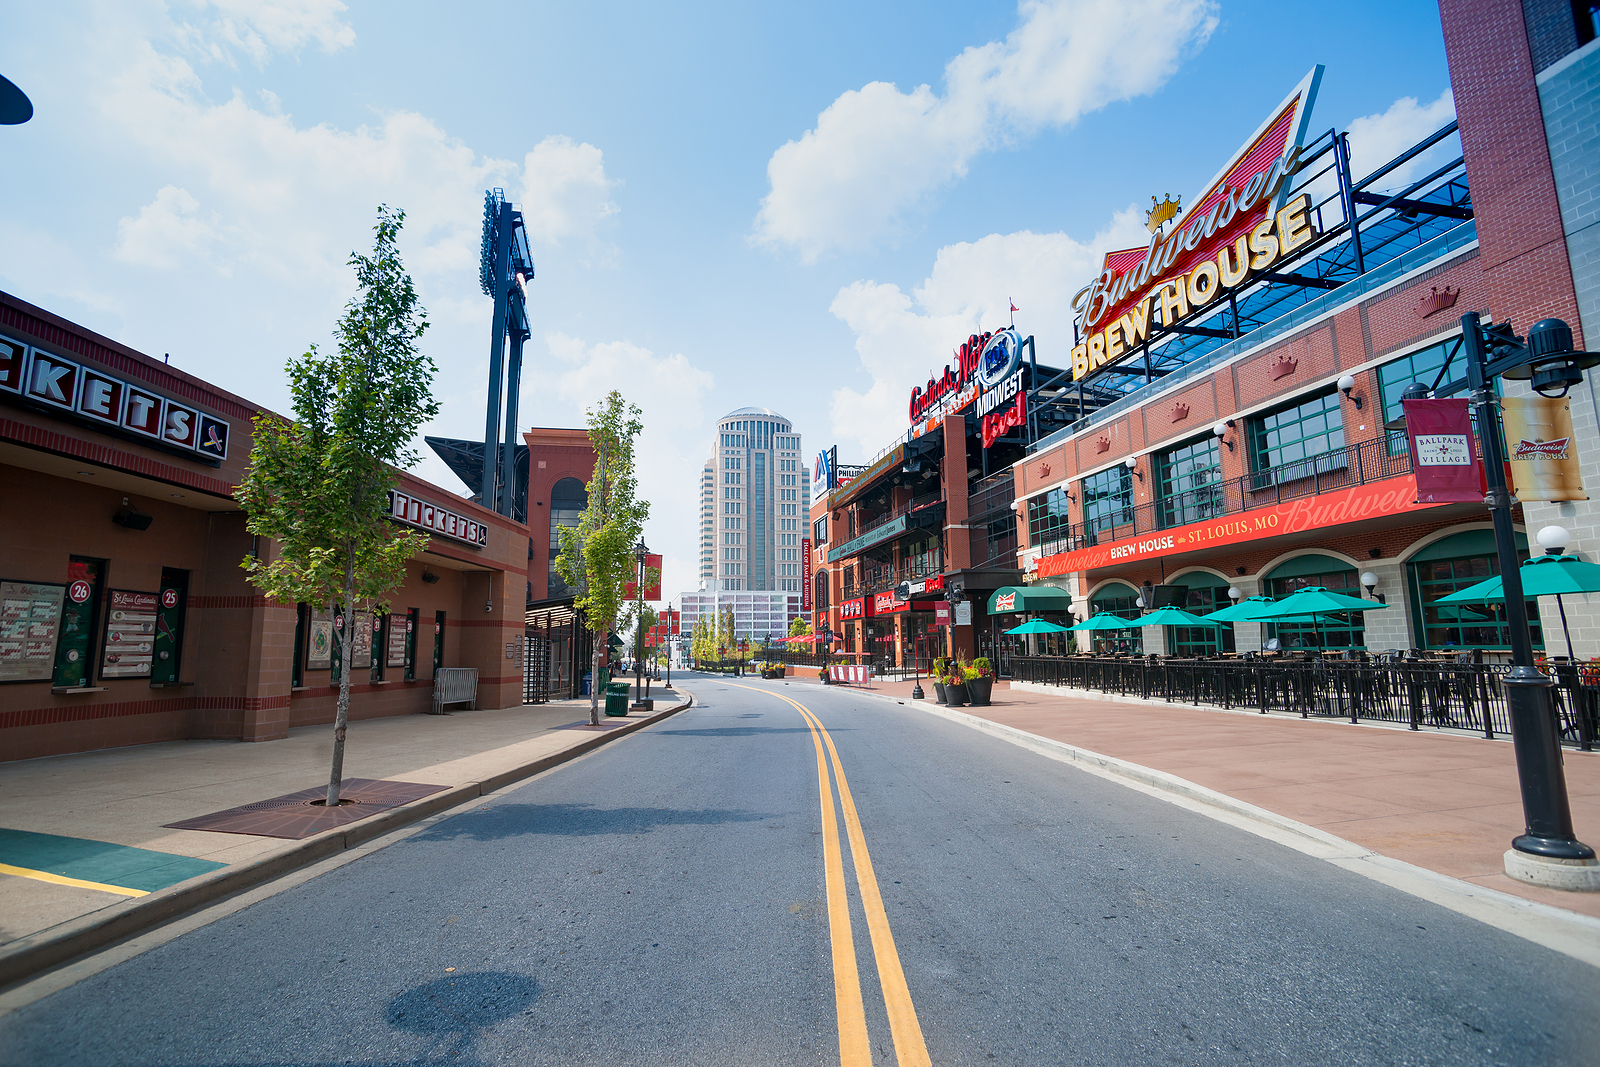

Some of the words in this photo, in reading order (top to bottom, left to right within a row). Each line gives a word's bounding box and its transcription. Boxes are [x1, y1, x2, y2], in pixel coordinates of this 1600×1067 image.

[1070, 145, 1302, 335] Budweiser
[1071, 296, 1155, 382] BREW
[1160, 193, 1317, 328] HOUSE
[985, 337, 1010, 371] FOX
[909, 365, 957, 426] Cardinals
[954, 327, 1006, 393] Nati
[976, 368, 1024, 419] MIDWEST
[982, 391, 1026, 448] Bud
[1419, 437, 1464, 446] BALLPARK
[1512, 442, 1569, 454] Budweiser
[1512, 453, 1536, 461] BREW
[397, 496, 477, 541] TICKETS
[1188, 528, 1205, 544] ST.
[1207, 521, 1253, 542] LOUIS,
[1254, 514, 1279, 530] MO
[804, 555, 809, 563] OF
[1110, 542, 1137, 560] BREW
[1138, 534, 1174, 555] HOUSE
[1038, 549, 1109, 577] Budweiser
[74, 585, 87, 598] 26
[134, 594, 156, 605] Cardinals
[165, 592, 176, 604] 25
[336, 618, 343, 627] 22
[374, 621, 380, 629] 21
